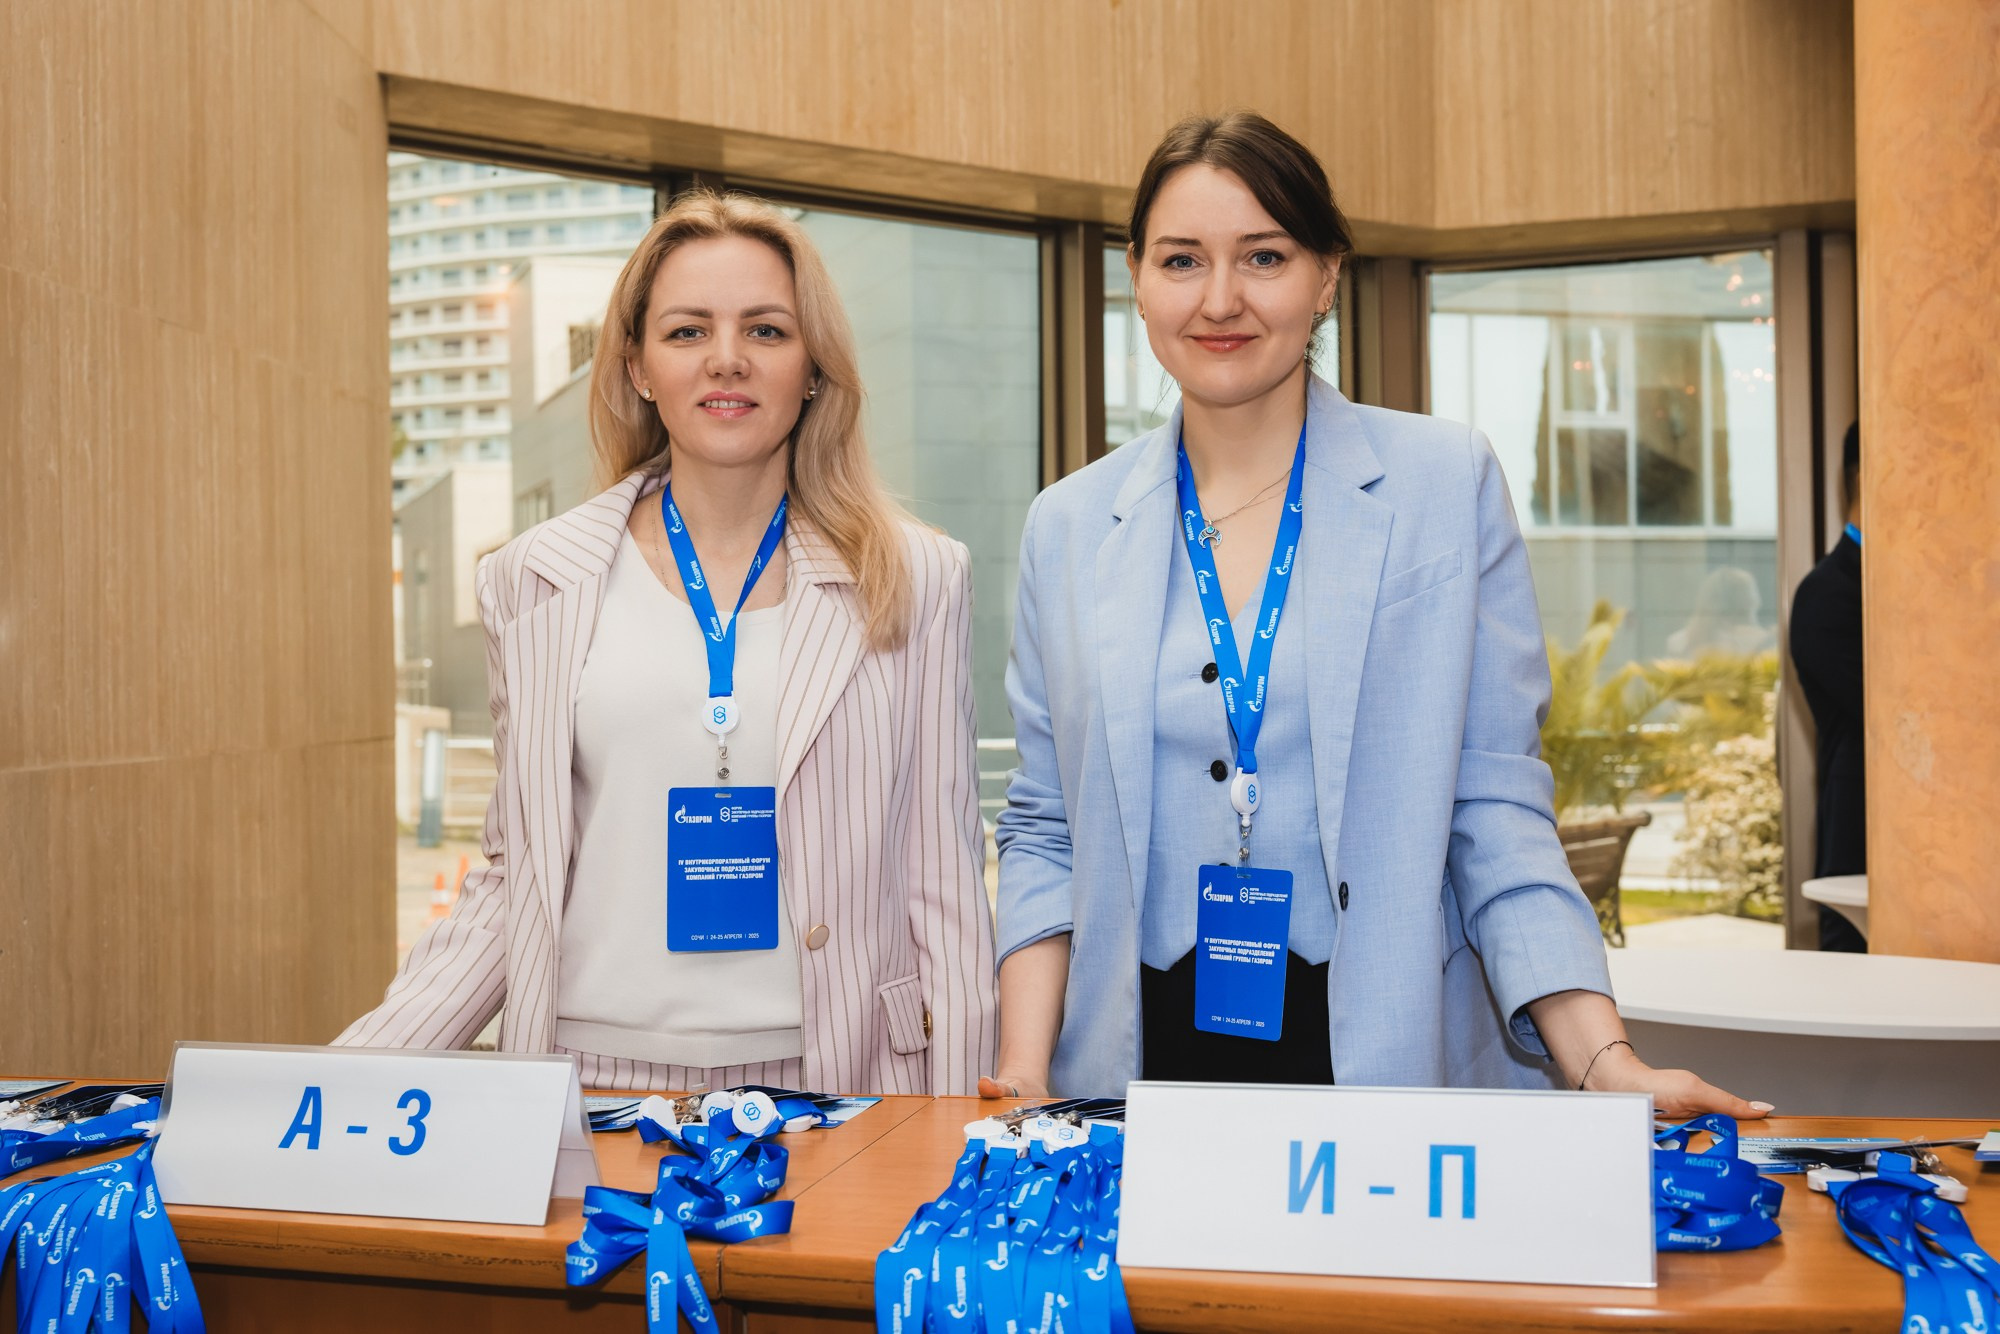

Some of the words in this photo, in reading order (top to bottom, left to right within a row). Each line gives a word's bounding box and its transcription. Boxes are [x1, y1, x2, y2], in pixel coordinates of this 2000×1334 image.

[685, 857, 750, 865] ВНУТРИКОРПОРАТИВНЫЙ
[721, 864, 765, 872] ПОДРАЗДЕЛЕНИЙ
[278, 1086, 322, 1150] А
[388, 1088, 432, 1156] З
[1288, 1140, 1336, 1215] И
[1428, 1144, 1476, 1219] П
